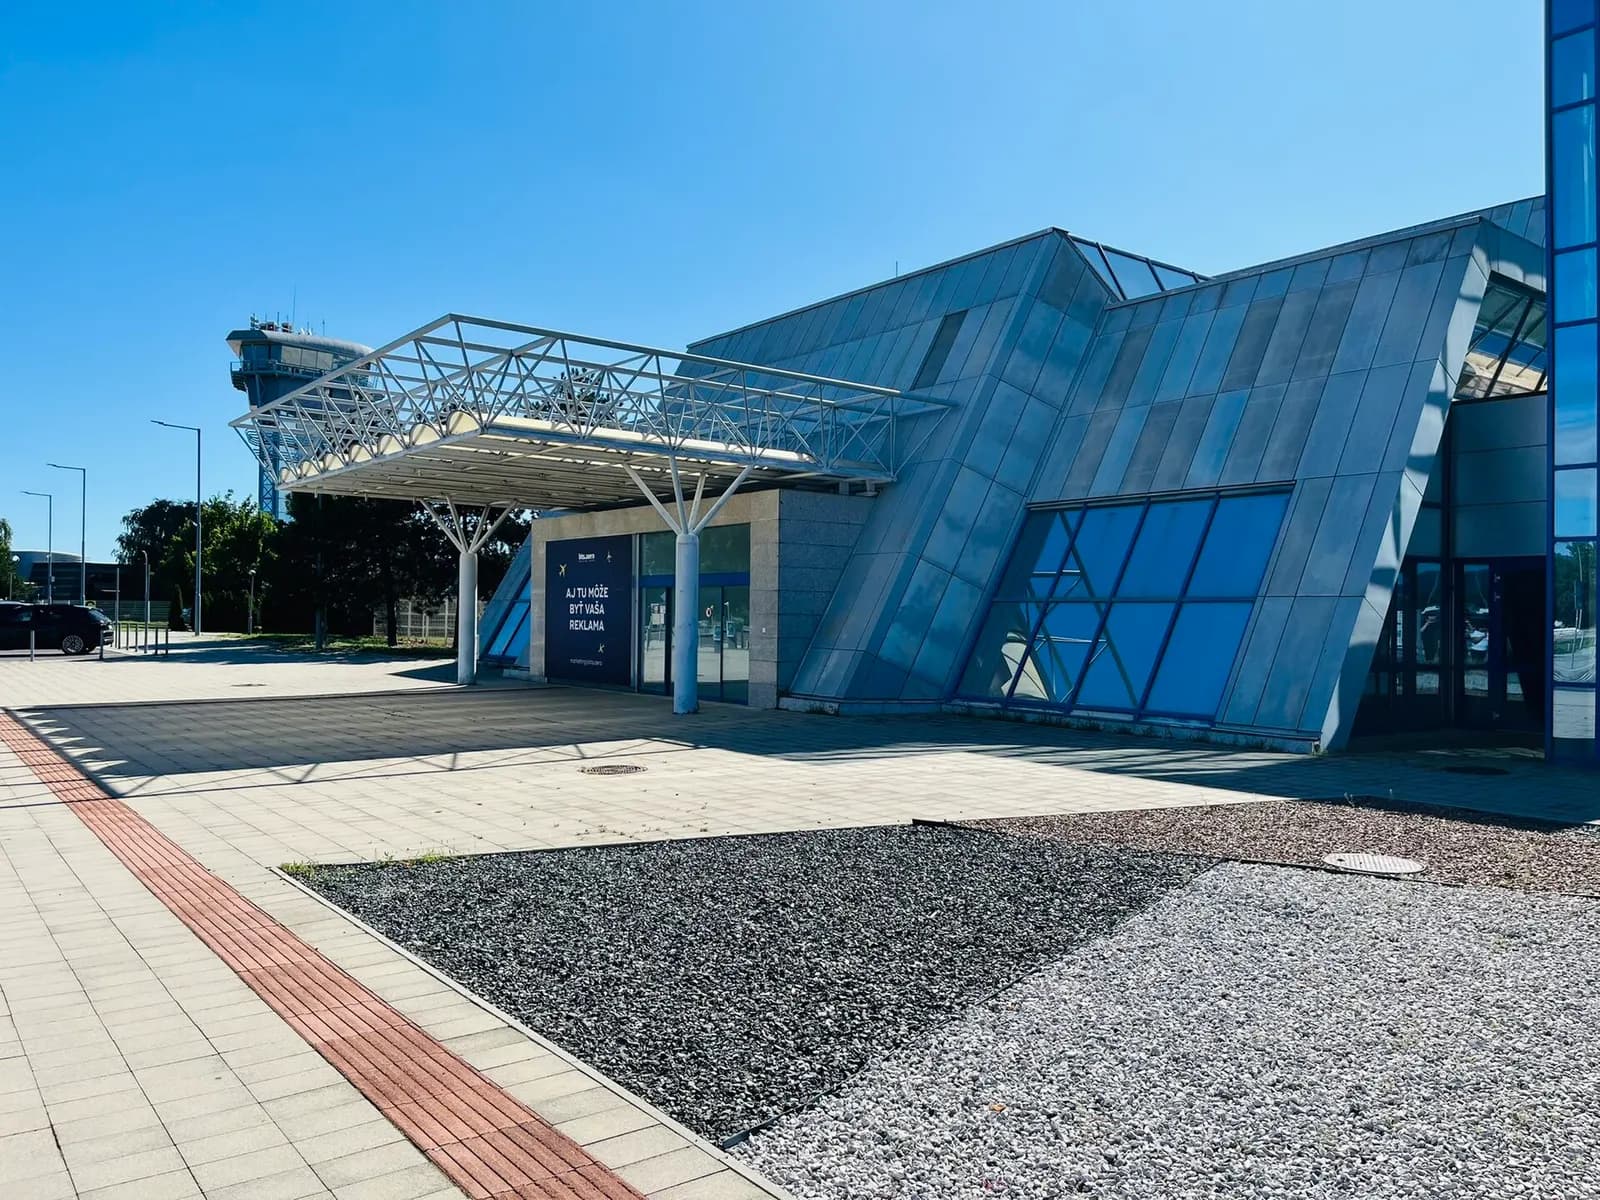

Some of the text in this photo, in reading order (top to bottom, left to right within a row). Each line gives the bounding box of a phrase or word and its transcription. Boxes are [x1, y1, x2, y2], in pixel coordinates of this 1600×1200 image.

[565, 584, 608, 598] AJ TU MÔŽE
[569, 600, 605, 615] BYŤ VAŠA
[569, 619, 605, 631] REKLAMA
